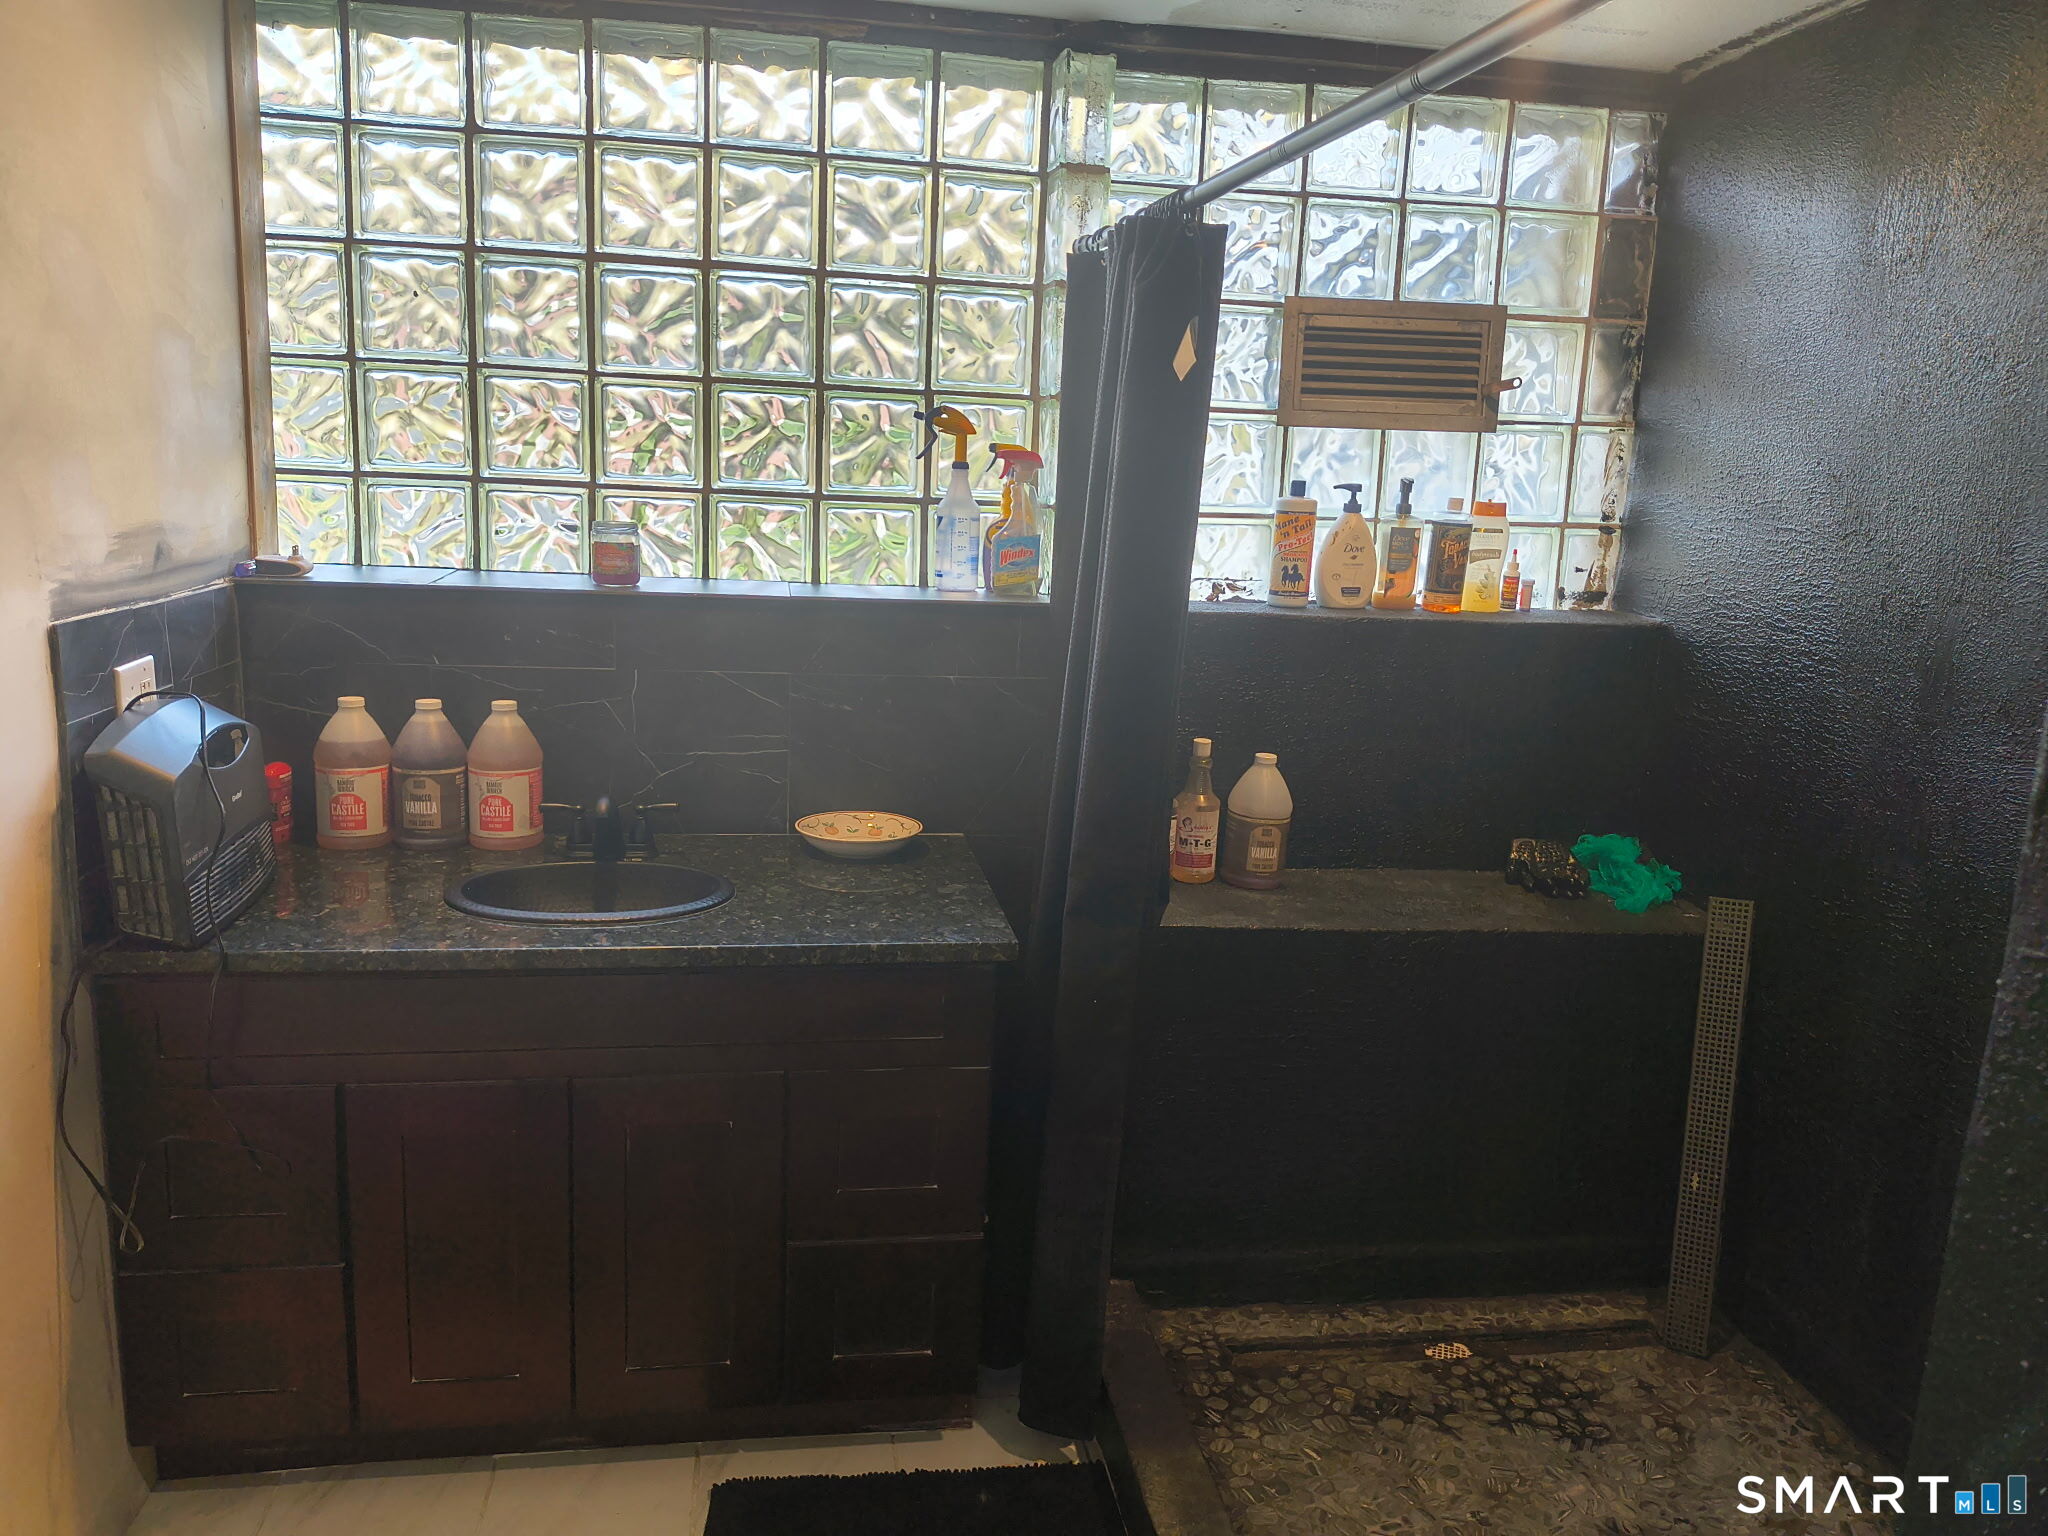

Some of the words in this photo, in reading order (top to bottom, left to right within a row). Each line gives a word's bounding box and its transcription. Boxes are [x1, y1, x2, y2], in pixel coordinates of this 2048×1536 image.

[1275, 516, 1300, 531] Mane
[1292, 519, 1312, 534] Tail
[1343, 543, 1365, 553] Dove
[999, 546, 1035, 568] Windex
[339, 796, 354, 804] PURE
[487, 798, 502, 806] PURE
[331, 803, 365, 815] CASTILE
[405, 801, 437, 814] VANILLA
[480, 805, 511, 817] CASTILE
[1250, 847, 1278, 859] VANILLA
